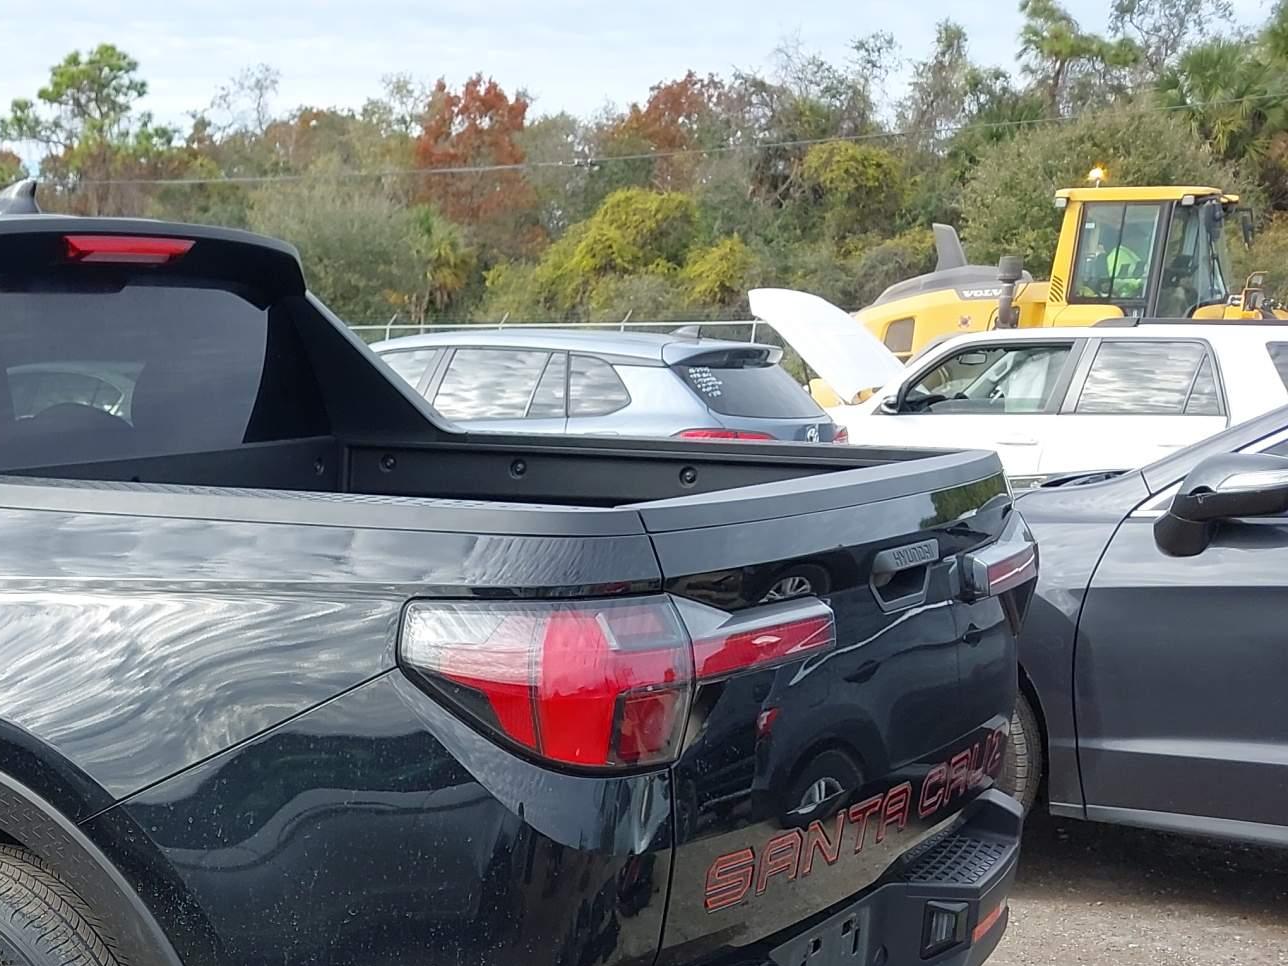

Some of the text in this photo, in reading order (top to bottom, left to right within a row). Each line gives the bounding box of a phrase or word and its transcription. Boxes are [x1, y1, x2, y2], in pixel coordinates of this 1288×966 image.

[962, 288, 1002, 298] VOLV
[892, 543, 934, 567] HYUNDAI
[704, 728, 1001, 913] SANTA CRUZ
